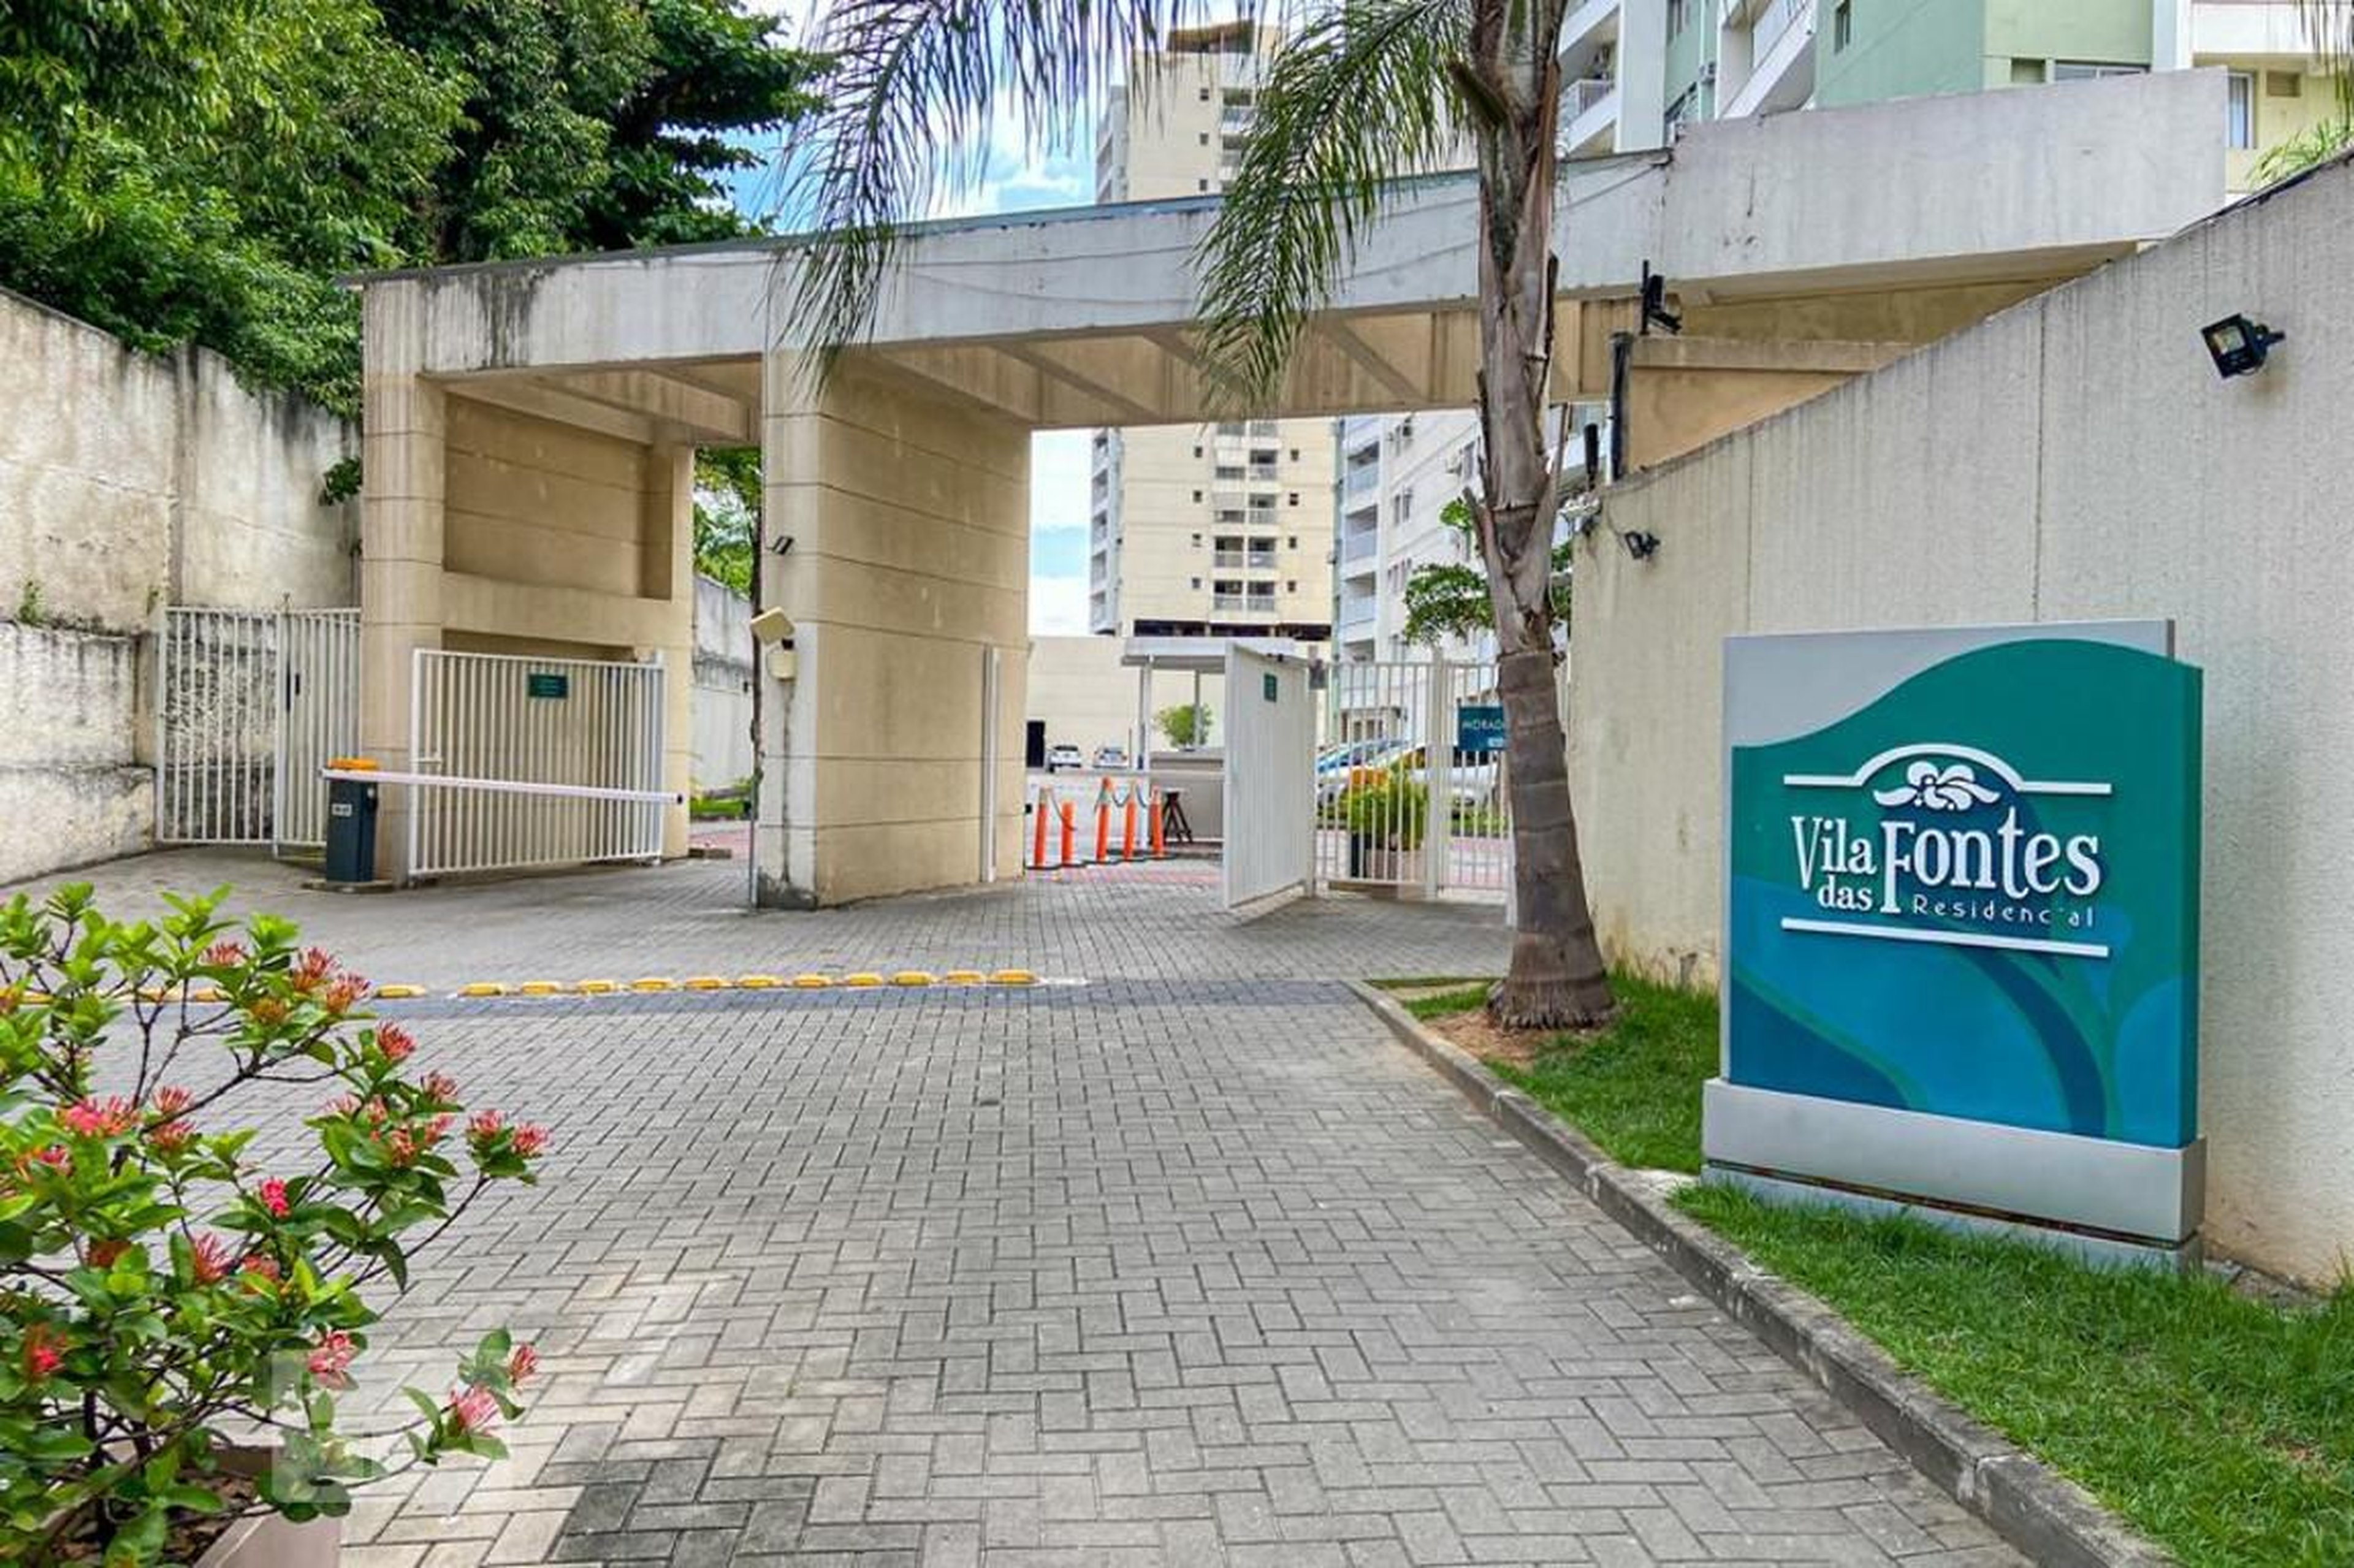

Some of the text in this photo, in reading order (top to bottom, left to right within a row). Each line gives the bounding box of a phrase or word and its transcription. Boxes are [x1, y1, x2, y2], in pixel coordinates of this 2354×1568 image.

[1461, 718, 1506, 730] MORAD
[1791, 805, 2101, 913] Vila das Fontes
[1912, 893, 2093, 927] Residencal
